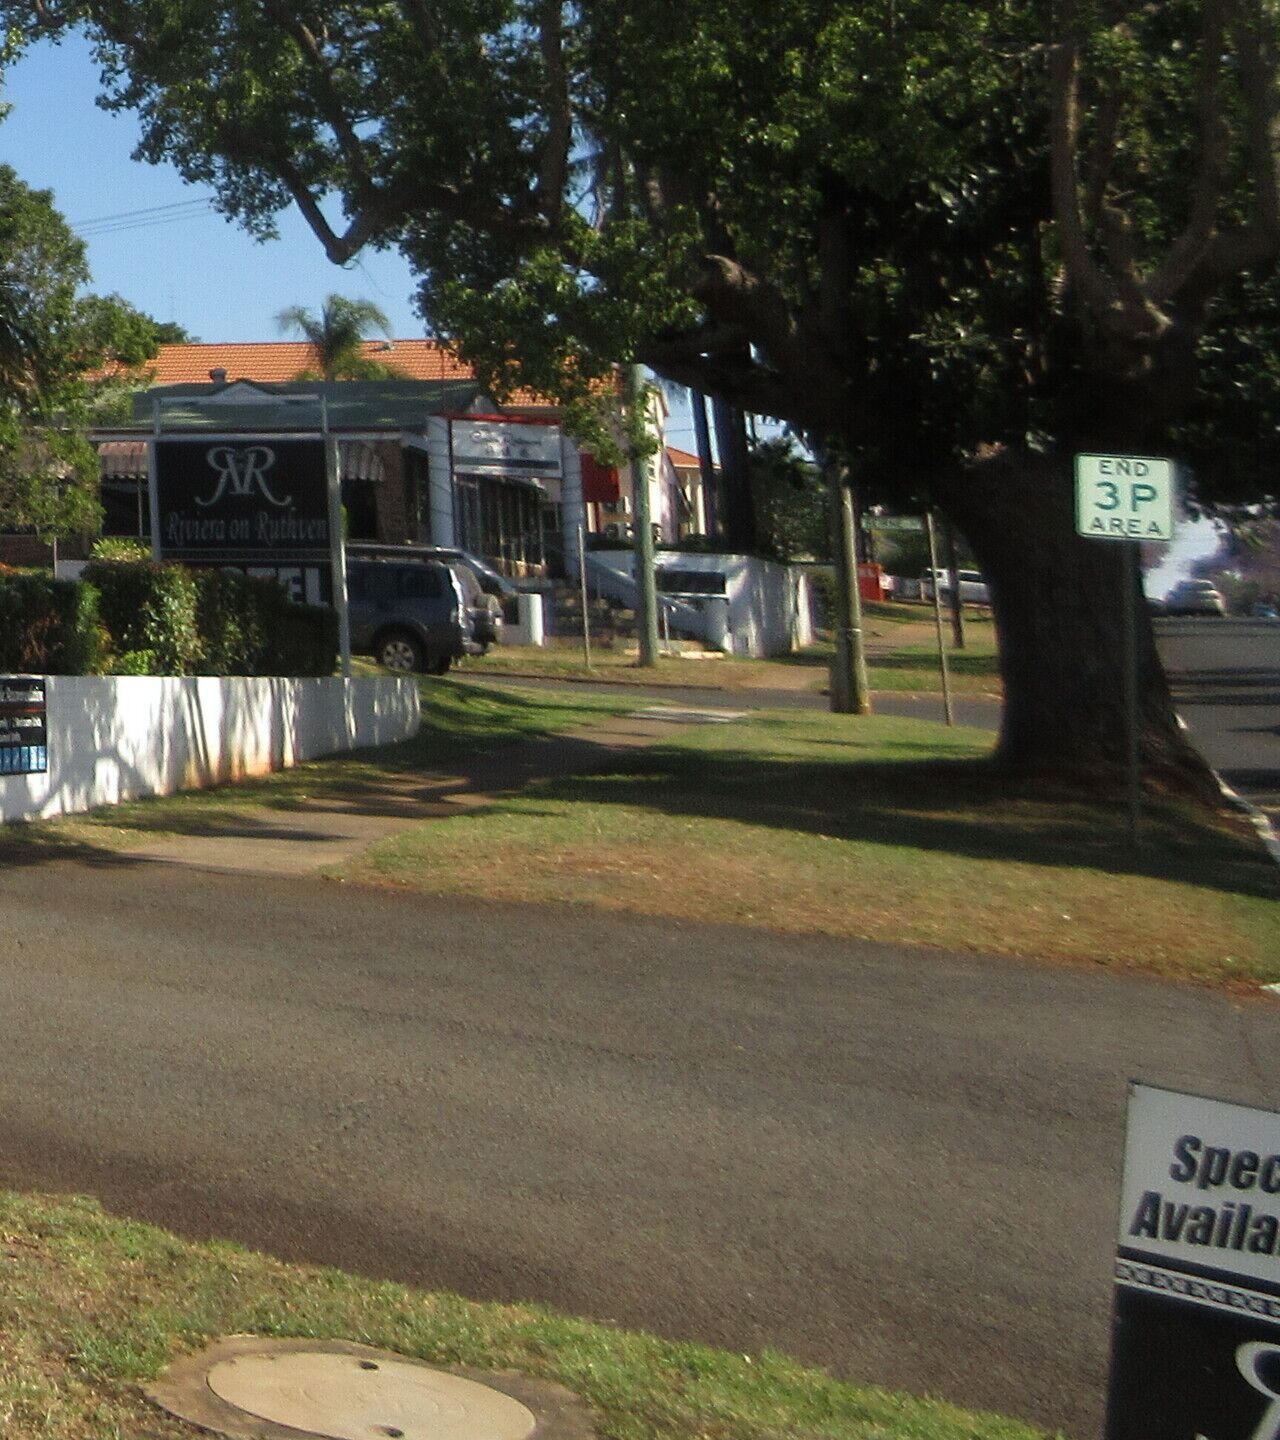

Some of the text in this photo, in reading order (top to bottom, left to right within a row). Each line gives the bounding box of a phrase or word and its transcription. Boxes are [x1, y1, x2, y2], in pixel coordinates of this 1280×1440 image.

[1099, 460, 1149, 476] END
[1095, 481, 1157, 512] 3P
[1090, 516, 1163, 536] AREA
[1169, 1134, 1280, 1194] Spec
